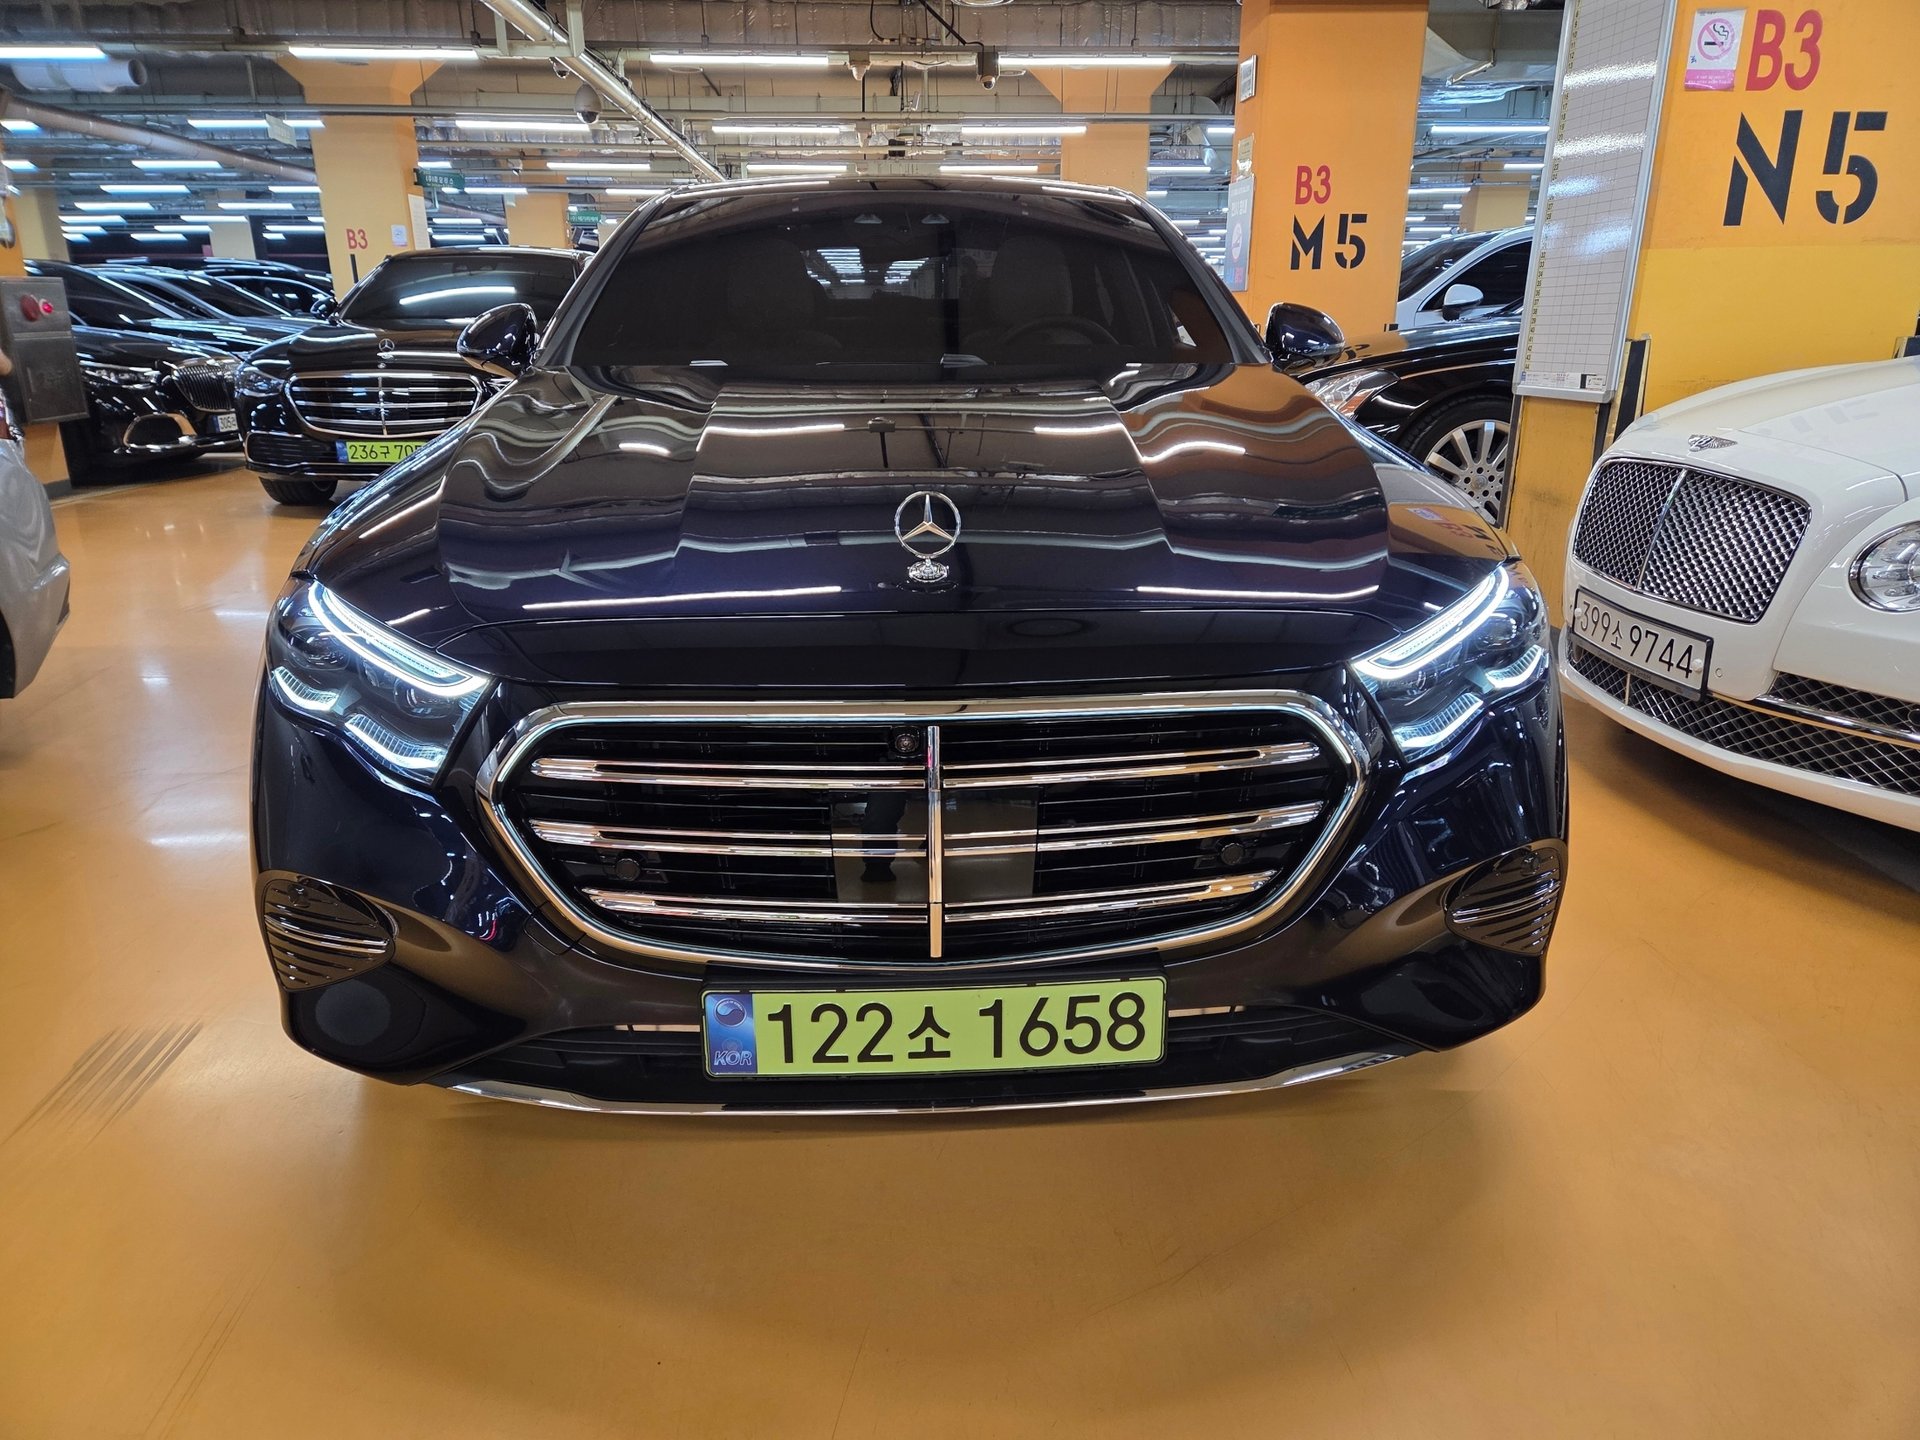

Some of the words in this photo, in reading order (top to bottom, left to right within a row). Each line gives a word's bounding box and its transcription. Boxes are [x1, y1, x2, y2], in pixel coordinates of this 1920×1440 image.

[1745, 9, 1823, 91] B3
[1295, 165, 1331, 205] B3
[346, 229, 368, 250] B3
[349, 444, 390, 460] 236구
[1580, 601, 1622, 650] 399소
[1629, 625, 1692, 678] 9744
[767, 1003, 951, 1064] 122소
[979, 992, 1146, 1059] 1658
[714, 1050, 752, 1066] KOR
